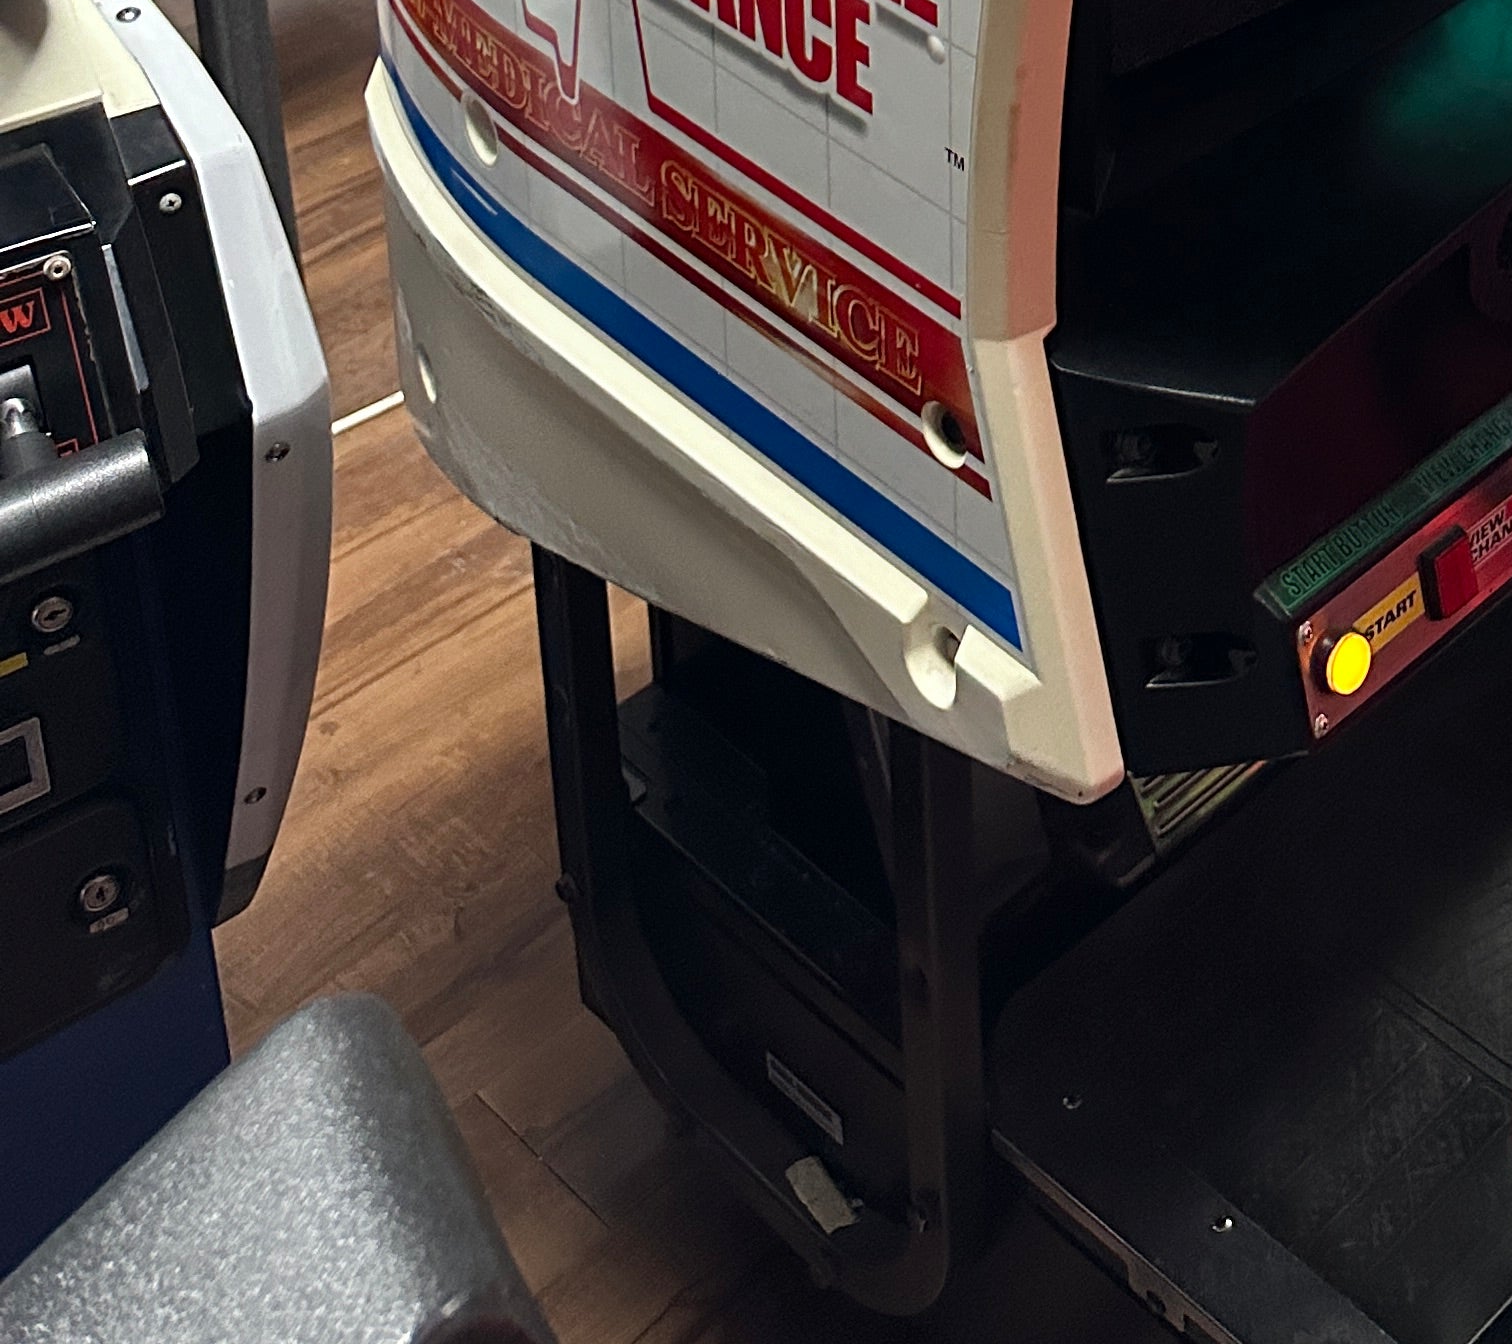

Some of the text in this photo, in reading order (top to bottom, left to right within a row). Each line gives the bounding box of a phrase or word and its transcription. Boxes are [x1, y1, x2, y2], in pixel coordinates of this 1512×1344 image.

[944, 146, 966, 172] TM
[661, 160, 922, 397] SERVICE
[1281, 541, 1338, 597] START
[1364, 589, 1417, 641] START
